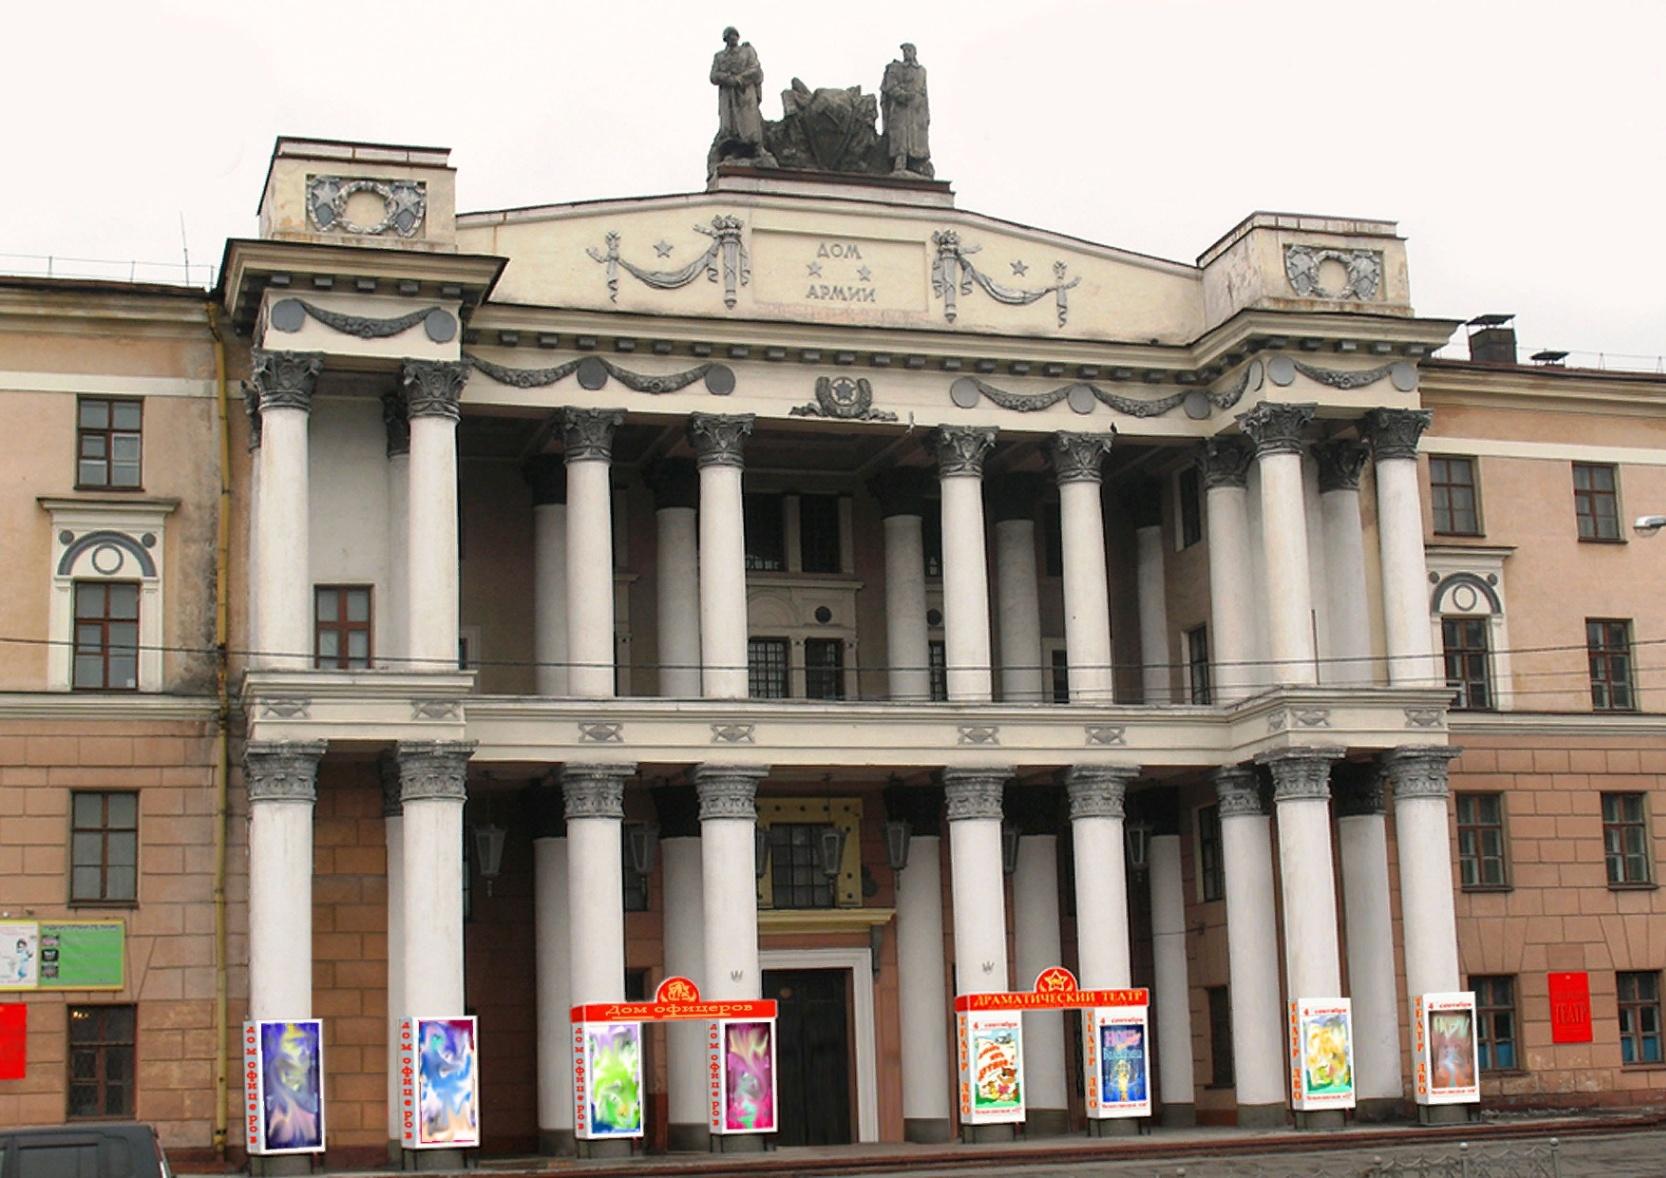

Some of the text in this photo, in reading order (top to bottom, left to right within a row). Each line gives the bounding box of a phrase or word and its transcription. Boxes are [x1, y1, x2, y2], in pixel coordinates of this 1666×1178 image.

[817, 242, 862, 260] ДОМ
[806, 284, 876, 303] АРМИИ
[1103, 990, 1143, 1001] ТЕАТР
[605, 1003, 753, 1016] Дом офицеров
